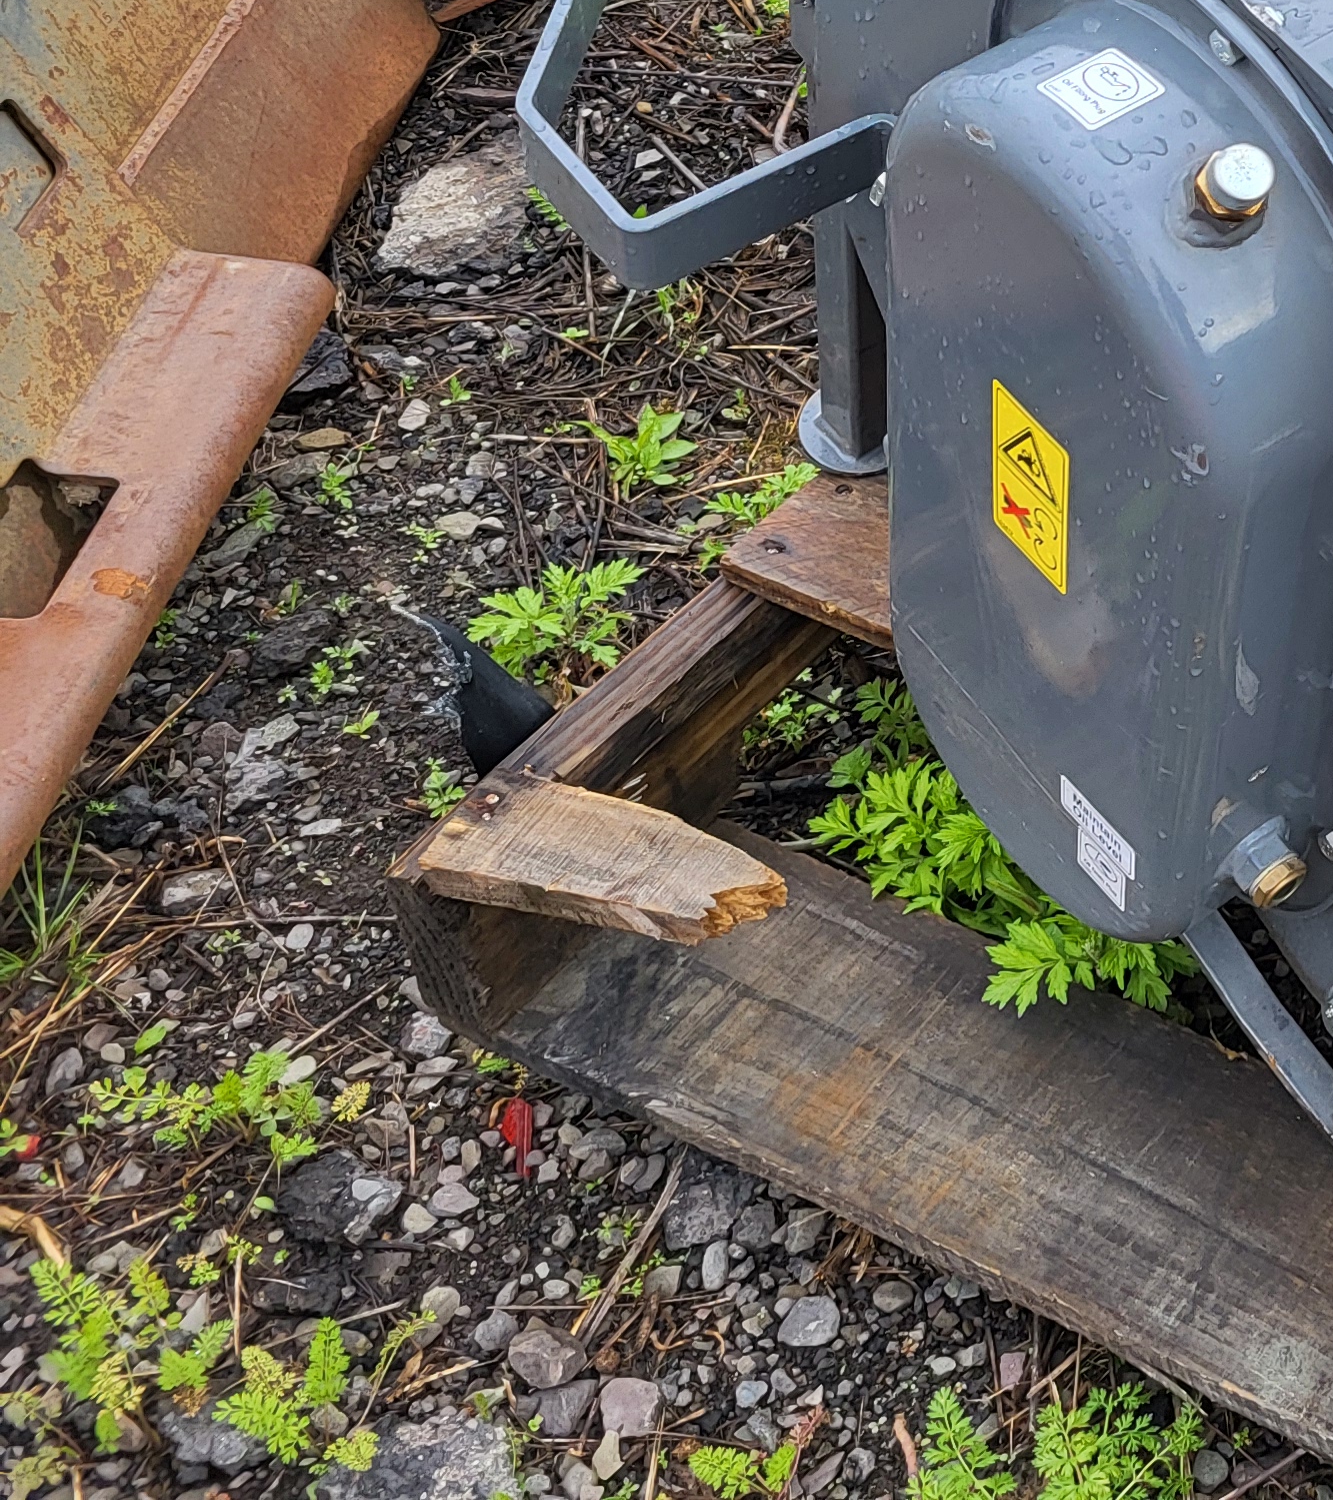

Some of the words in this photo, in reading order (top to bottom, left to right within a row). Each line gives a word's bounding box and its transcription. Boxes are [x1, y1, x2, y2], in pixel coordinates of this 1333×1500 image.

[1073, 792, 1120, 851] Maintain
[1073, 804, 1088, 827] Oil
[1092, 823, 1121, 862] Level
